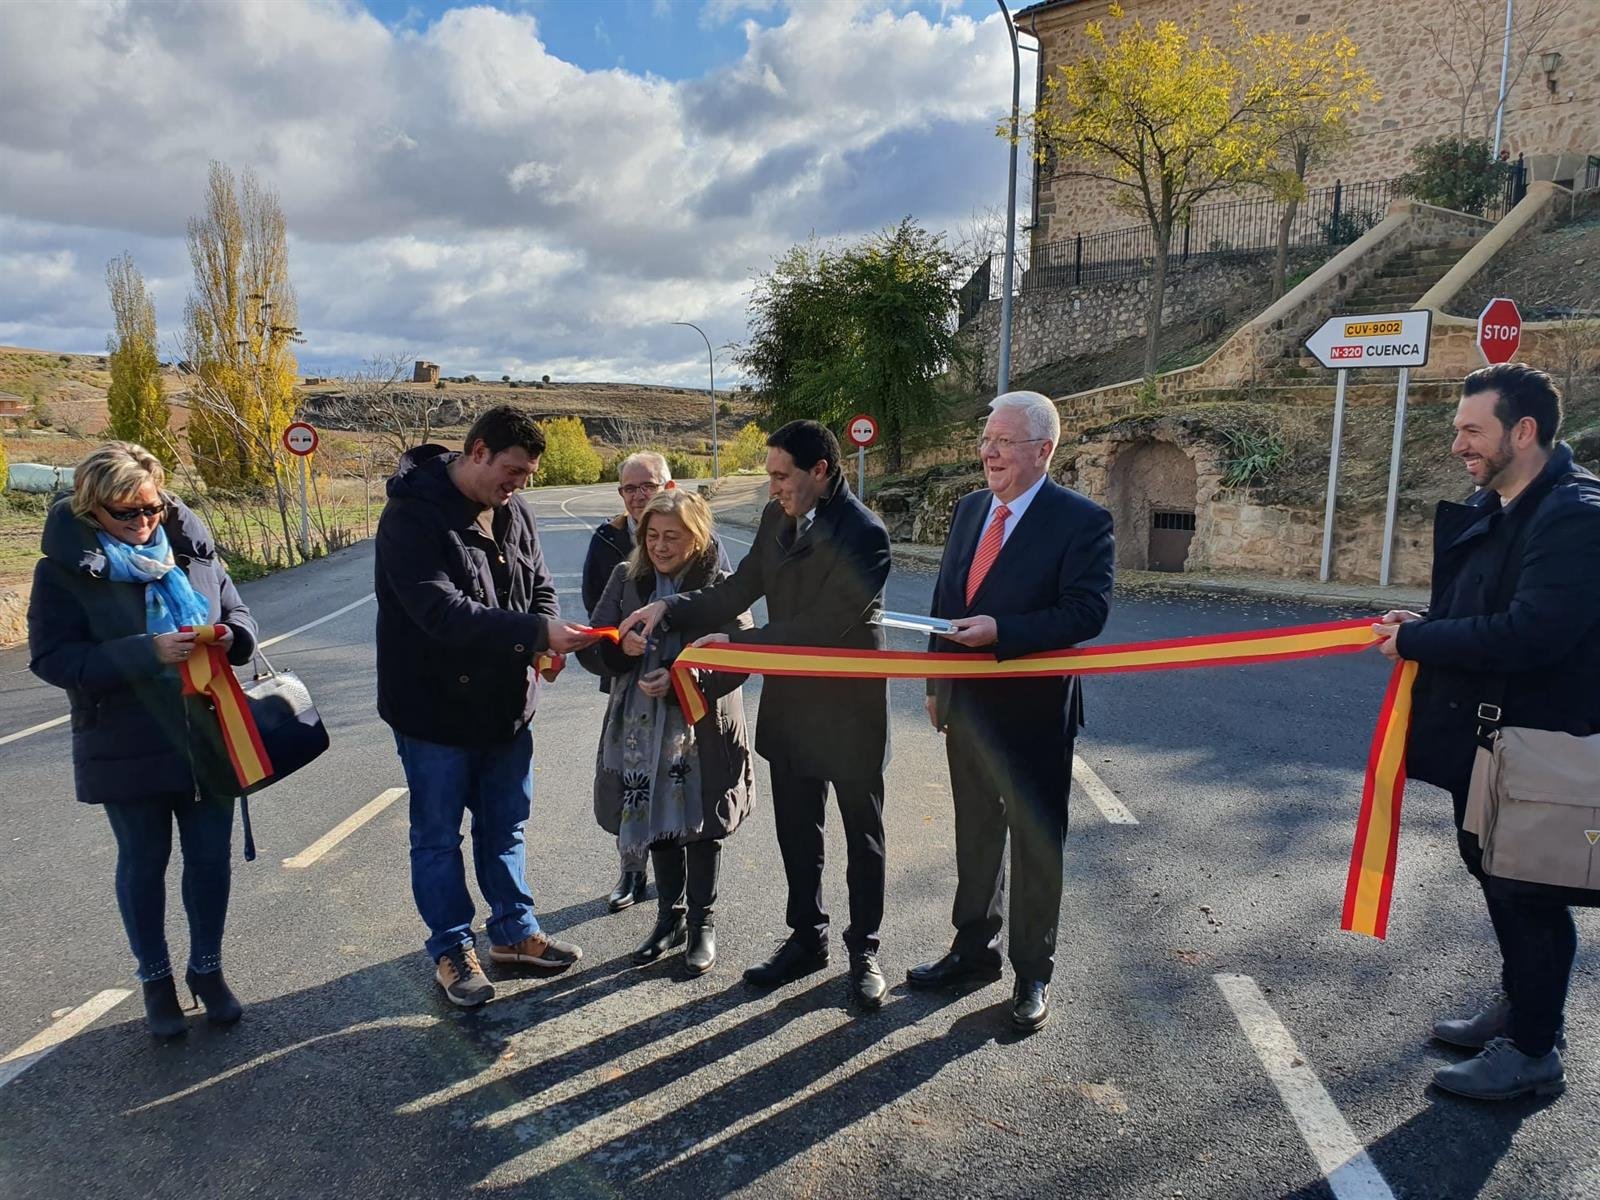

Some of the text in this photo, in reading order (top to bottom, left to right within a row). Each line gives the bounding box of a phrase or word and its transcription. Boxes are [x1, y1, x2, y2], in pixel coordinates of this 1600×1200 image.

[1346, 322, 1401, 336] CUV-9002
[1484, 324, 1518, 341] STOP
[1331, 343, 1420, 358] N-320 CUENCA
